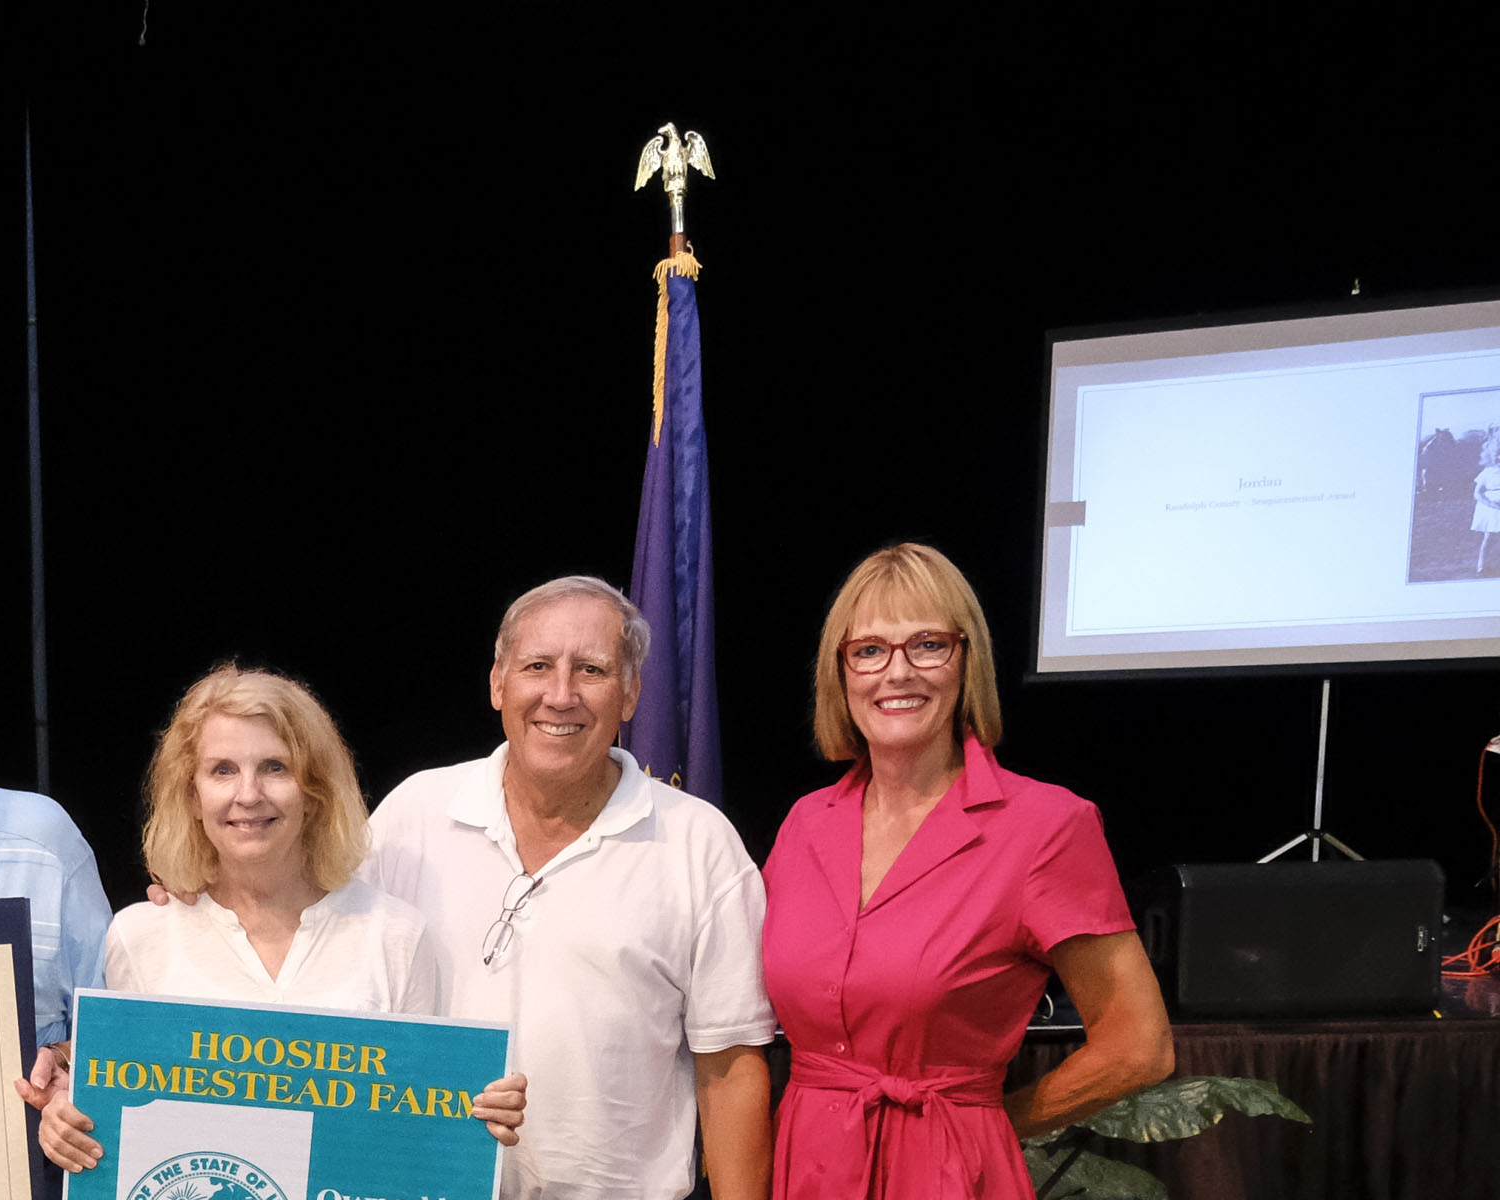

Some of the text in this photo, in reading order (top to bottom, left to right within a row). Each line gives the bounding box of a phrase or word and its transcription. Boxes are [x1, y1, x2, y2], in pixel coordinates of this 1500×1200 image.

[1236, 476, 1283, 493] Jordan
[189, 1031, 387, 1075] HOOSIER
[87, 1058, 356, 1108] HOMESTEAD
[153, 1163, 183, 1186] THE
[190, 1158, 240, 1175] STATE
[245, 1172, 267, 1191] OF
